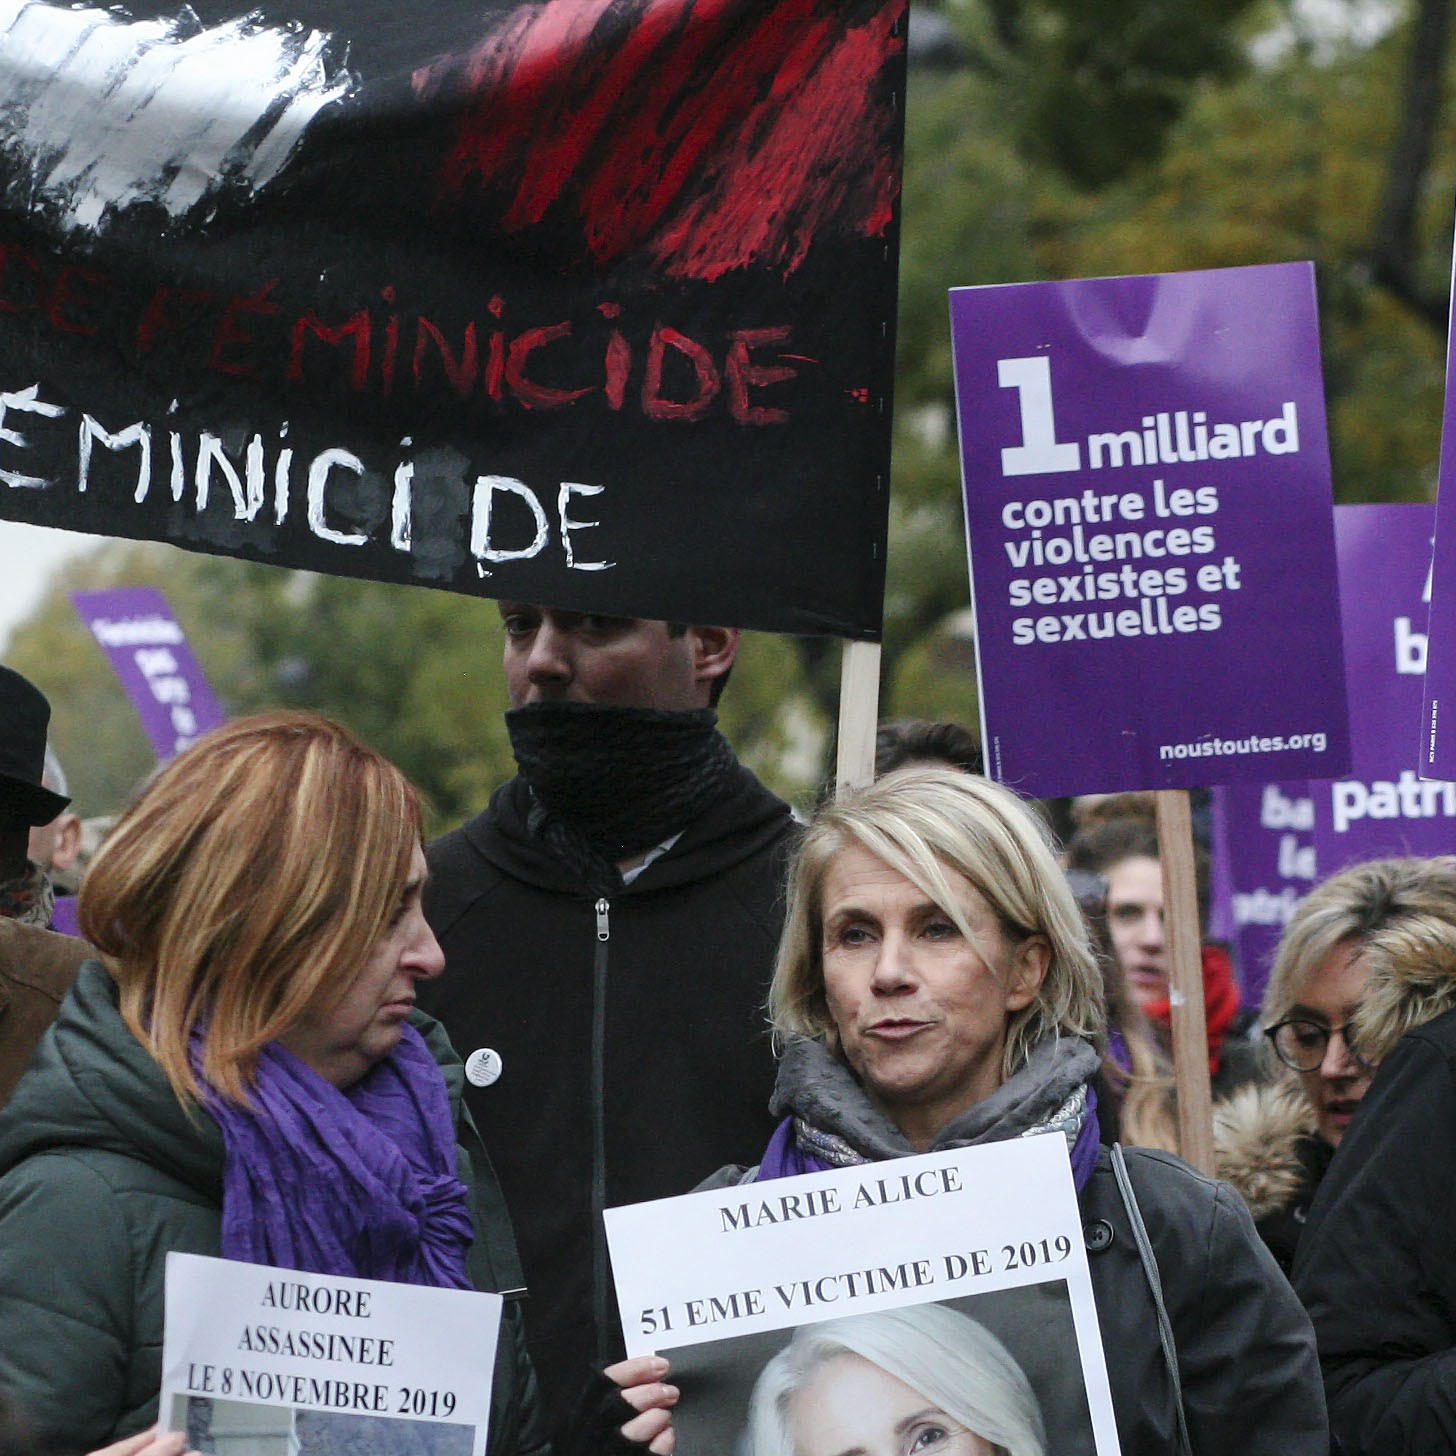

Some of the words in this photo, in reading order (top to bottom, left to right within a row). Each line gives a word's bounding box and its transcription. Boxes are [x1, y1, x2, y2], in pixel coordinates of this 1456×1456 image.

[997, 355, 1081, 477] 1
[1087, 401, 1300, 470] milliard
[1001, 489, 1146, 530] contre
[1153, 479, 1219, 518] les
[1003, 522, 1217, 569] violences
[1008, 563, 1189, 608] sexistes
[1196, 556, 1241, 592] et
[1010, 597, 1222, 645] sexuelles
[1159, 732, 1327, 761] noustoutes.org
[720, 1187, 842, 1233] MARIE
[852, 1166, 963, 1211] ALICE
[261, 1280, 372, 1319] AURORE
[640, 1305, 674, 1335] 51
[687, 1289, 766, 1328] EME
[774, 1259, 934, 1311] VICTIME
[945, 1248, 993, 1282] DE
[1002, 1234, 1072, 1273] 2019
[237, 1324, 395, 1367] ASSASSINEE
[187, 1362, 214, 1393] LE
[221, 1368, 233, 1395] 8
[239, 1370, 389, 1413] NOVEMBRE
[397, 1386, 457, 1418] 2019
